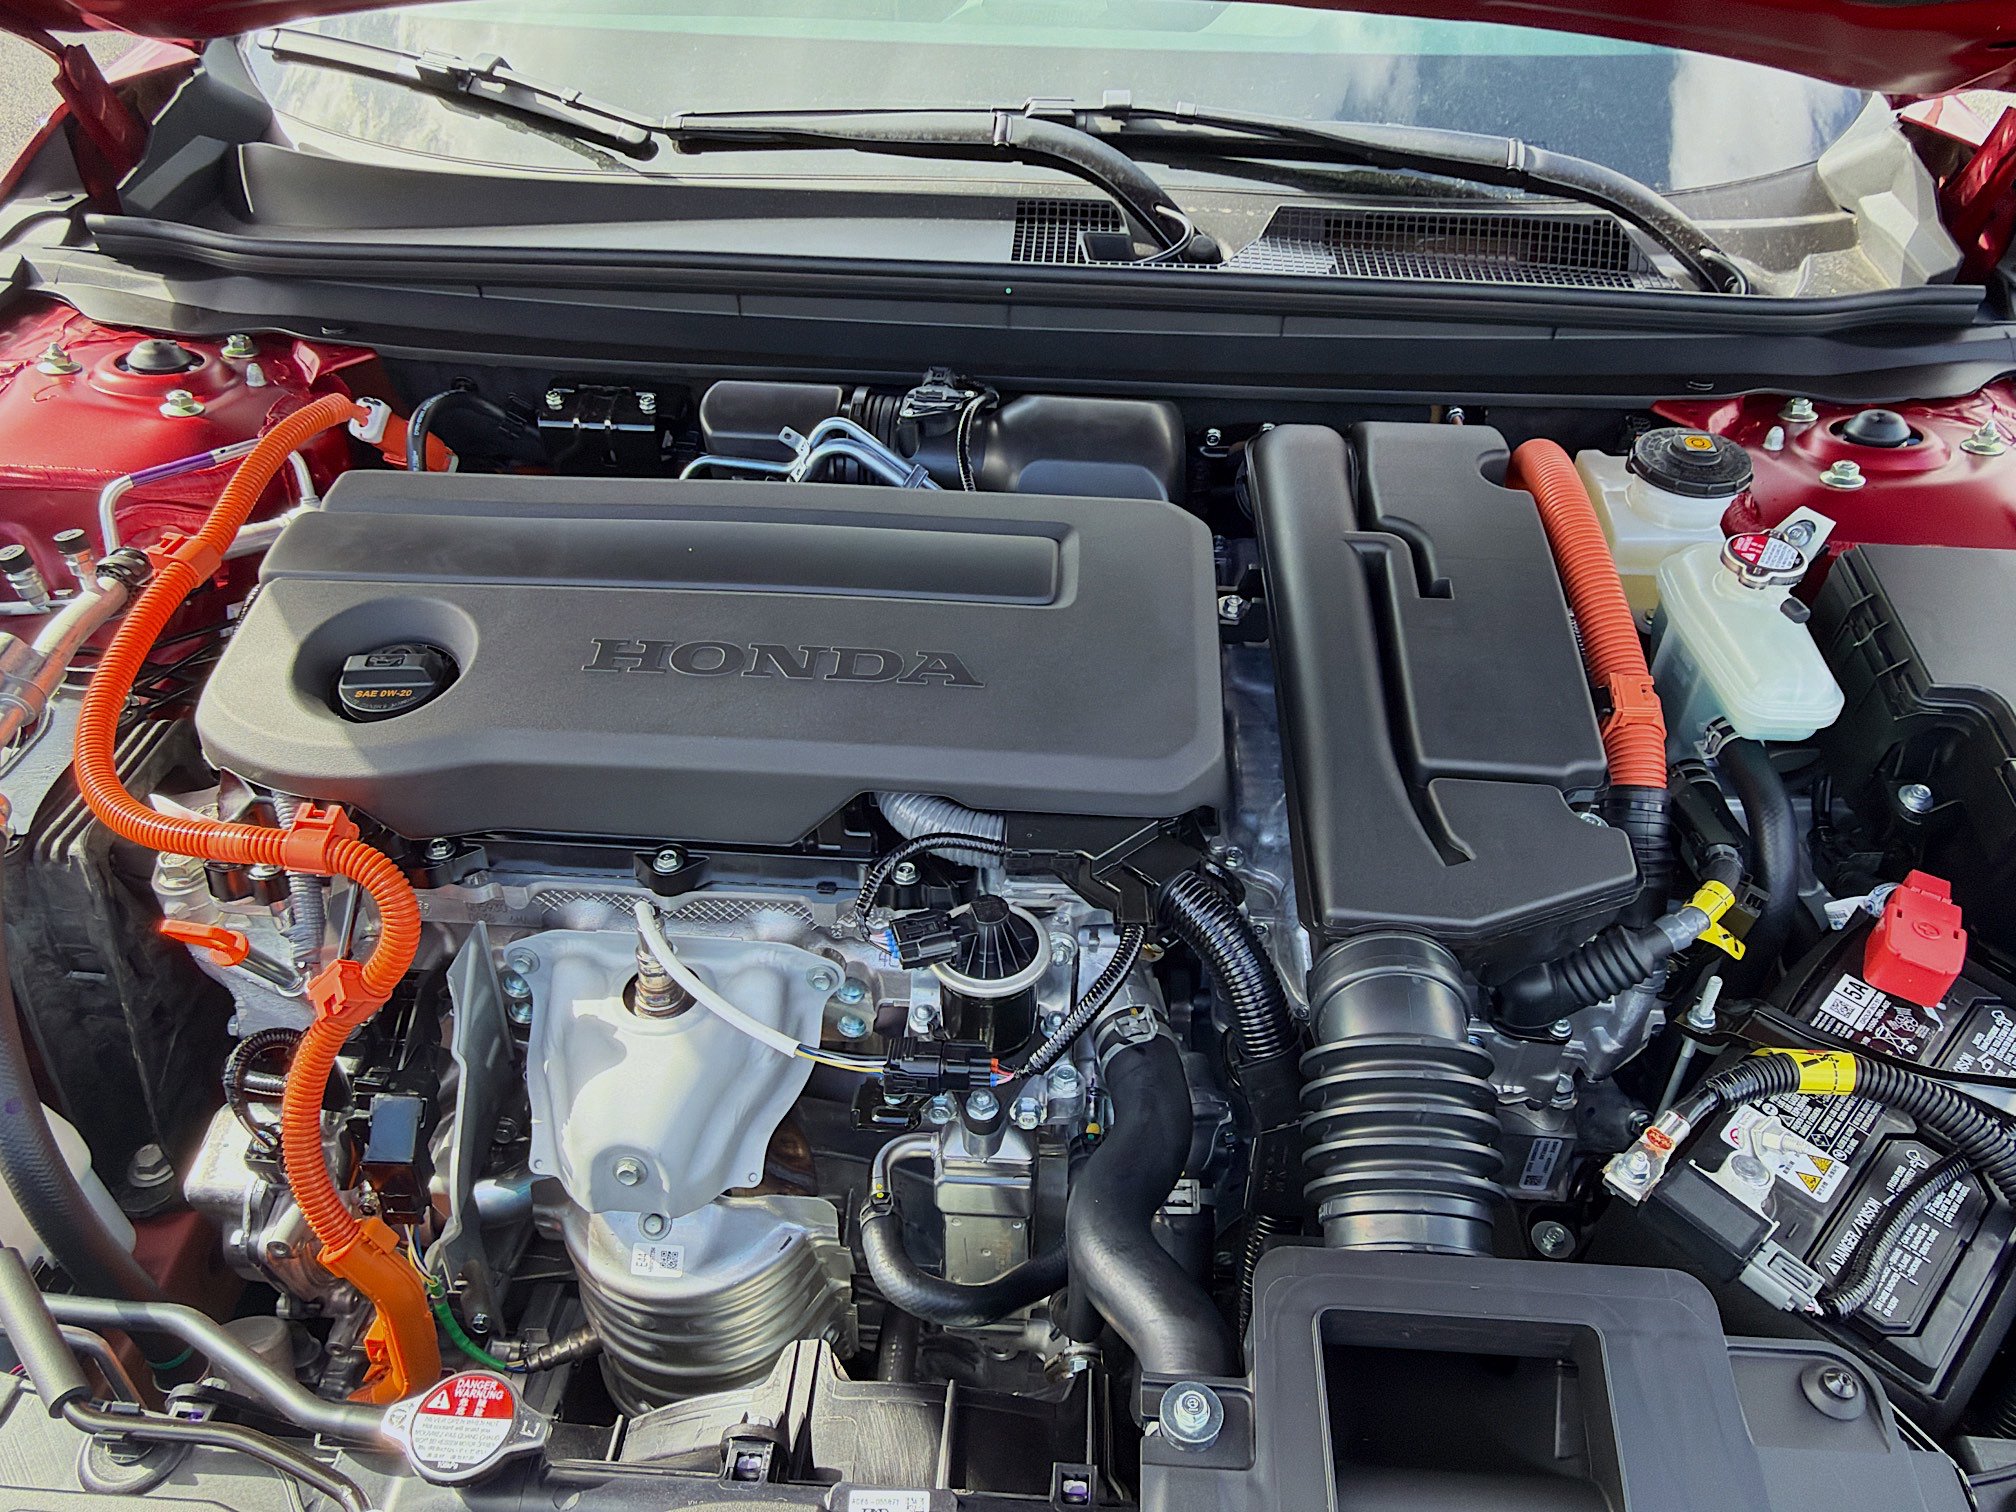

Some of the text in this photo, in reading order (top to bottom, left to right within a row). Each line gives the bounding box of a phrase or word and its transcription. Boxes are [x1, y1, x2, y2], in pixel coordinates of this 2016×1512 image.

[581, 637, 986, 688] HONDA
[354, 689, 413, 698] SAE 0W-20
[1843, 981, 1869, 1000] 5A
[455, 1379, 498, 1390] DANGER
[454, 1388, 504, 1401] WARNUNG
